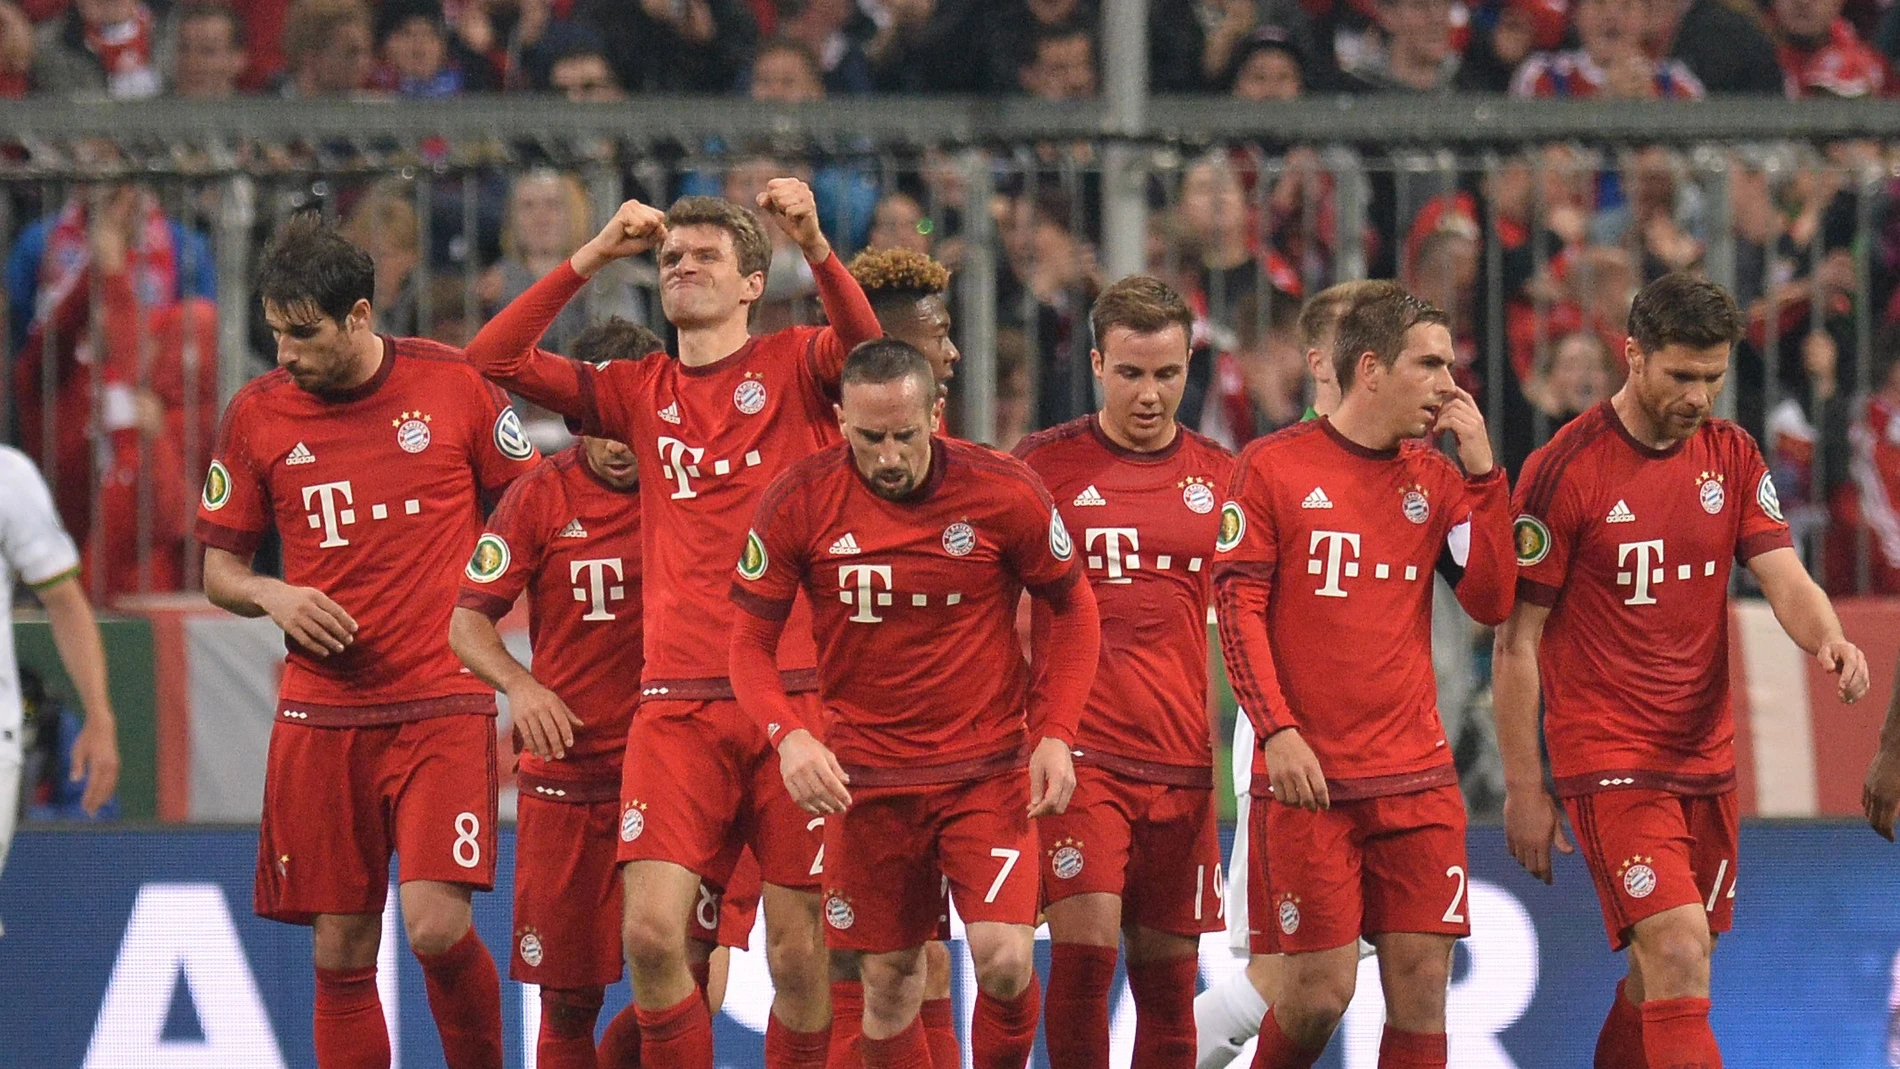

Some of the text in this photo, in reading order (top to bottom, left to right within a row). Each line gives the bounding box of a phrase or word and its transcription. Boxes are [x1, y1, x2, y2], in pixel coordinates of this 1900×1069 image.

[286, 455, 315, 466] adidas
[1073, 498, 1106, 507] adidas
[1301, 500, 1333, 509] adidas
[1606, 514, 1636, 523] adidas
[828, 546, 861, 555] adidas
[453, 812, 480, 868] 8
[984, 847, 1019, 903] 7
[1195, 862, 1225, 920] 19
[1442, 865, 1464, 923] 2
